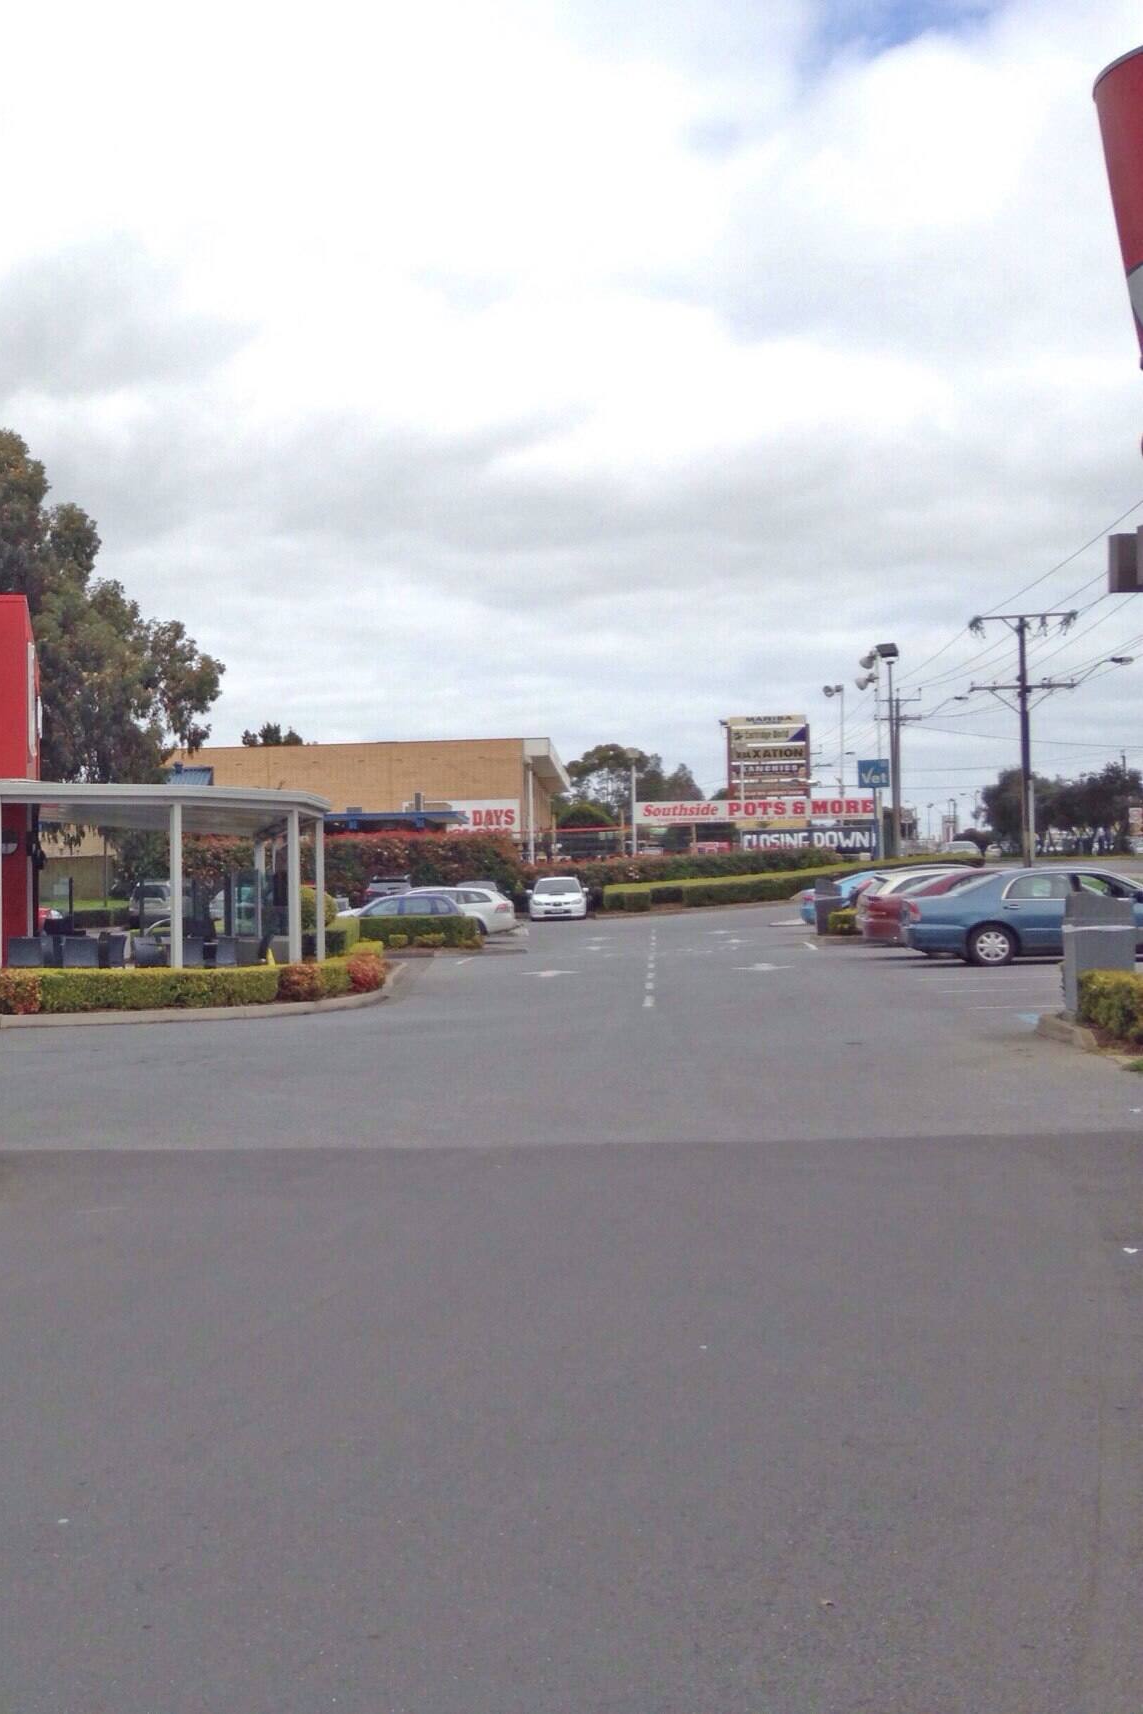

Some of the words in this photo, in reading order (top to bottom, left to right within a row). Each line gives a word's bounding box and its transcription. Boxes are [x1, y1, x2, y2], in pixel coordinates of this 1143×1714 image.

[861, 767, 887, 784] Vet
[472, 808, 516, 826] DAYS
[643, 803, 719, 817] Southside
[728, 801, 786, 816] POTS
[792, 801, 805, 815] &
[811, 799, 875, 814] MORE
